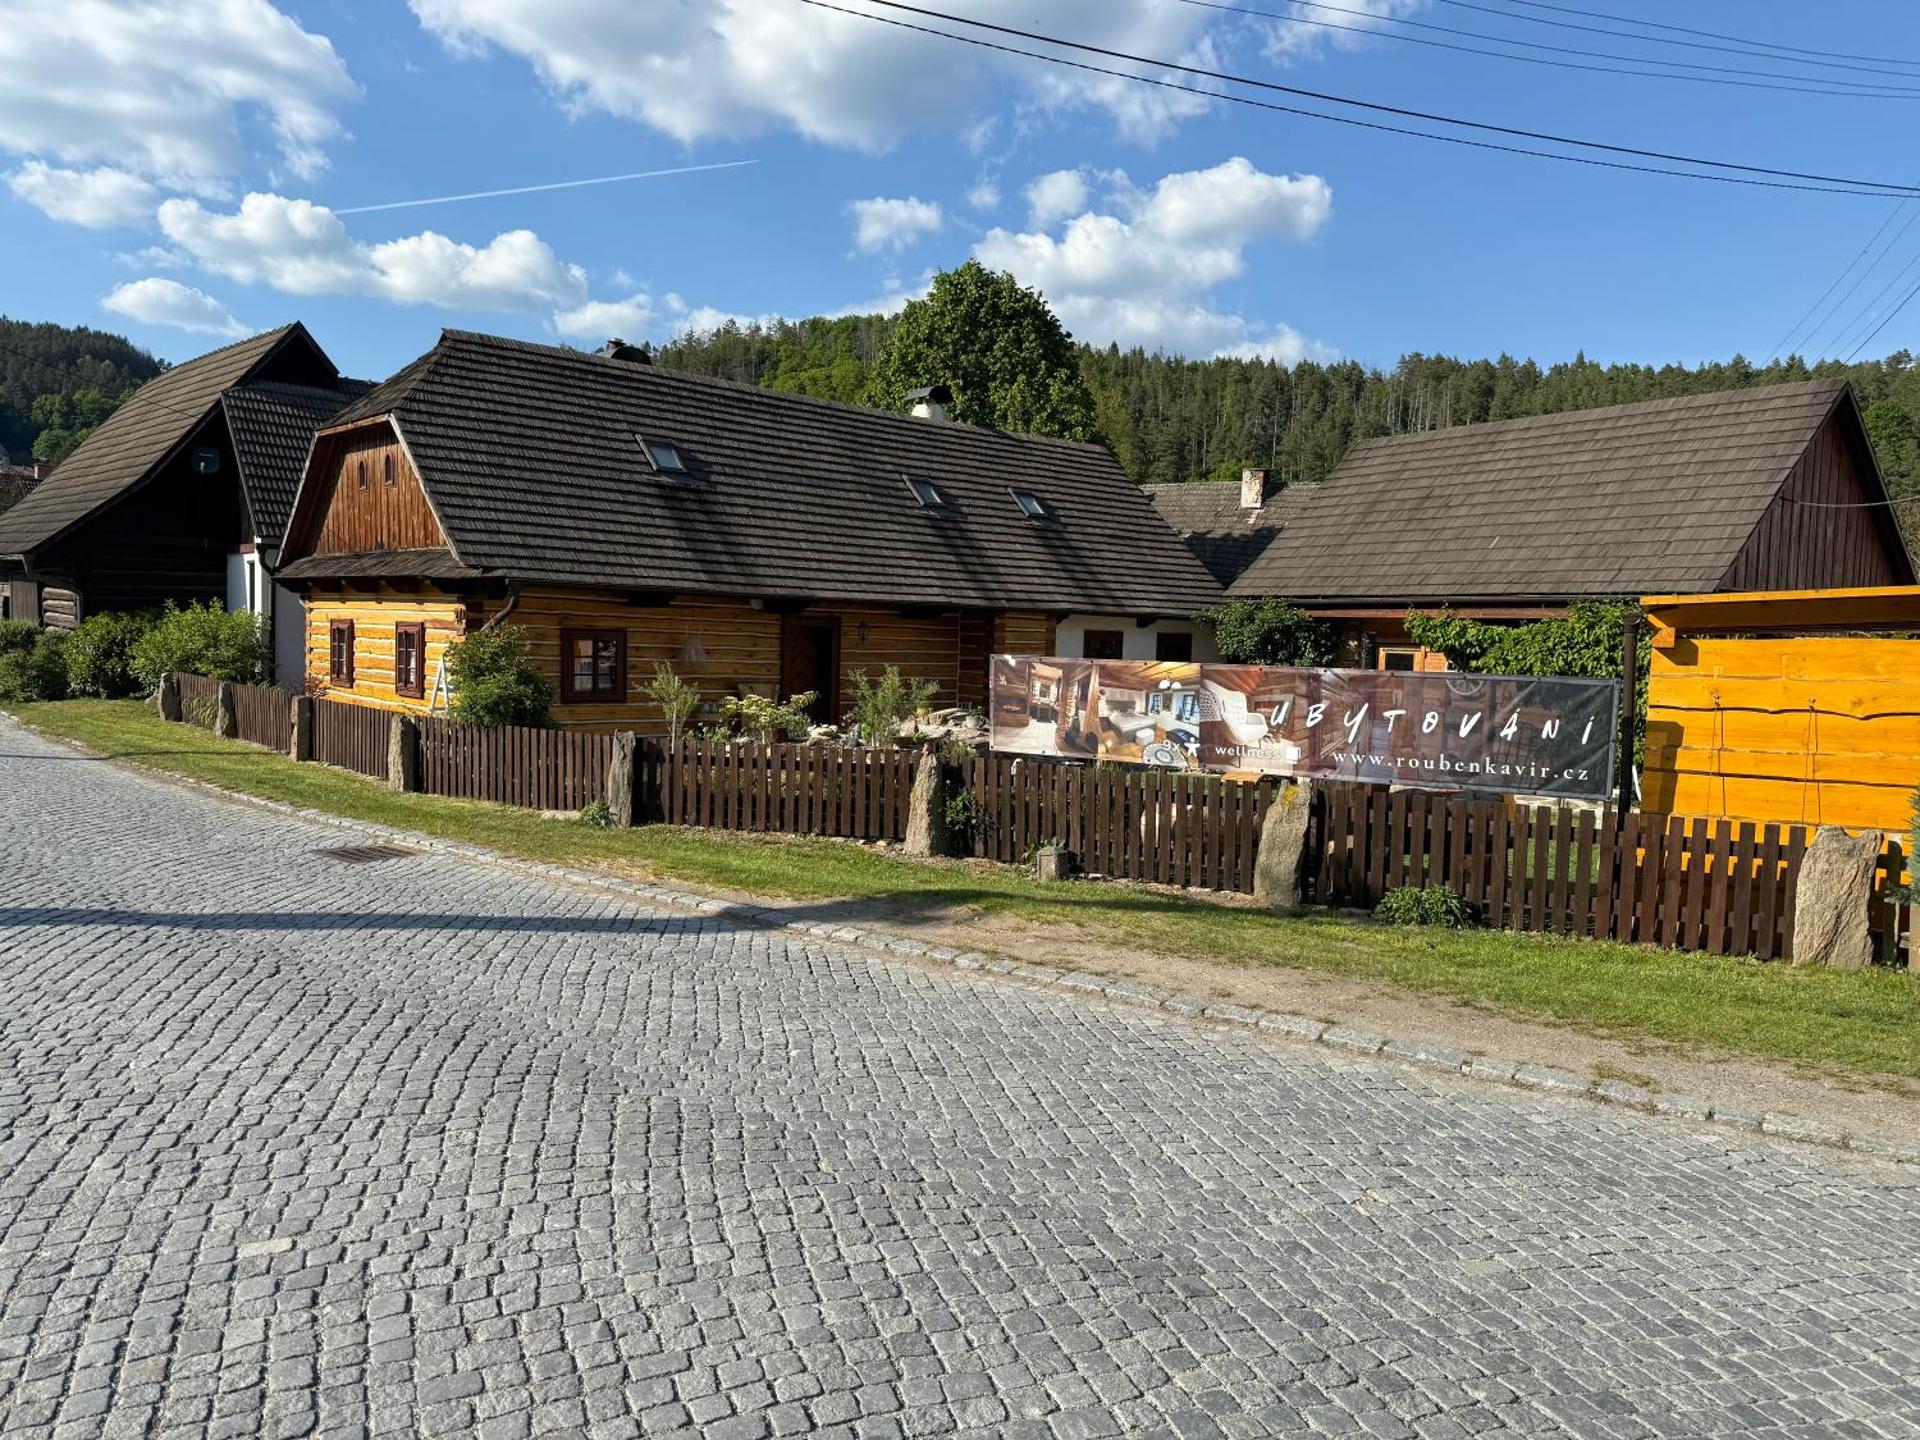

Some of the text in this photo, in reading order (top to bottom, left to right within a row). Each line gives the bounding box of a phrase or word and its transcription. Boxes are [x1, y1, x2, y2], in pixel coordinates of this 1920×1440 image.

[1270, 700, 1595, 745] UBYTOVÁNÍ
[1214, 744, 1281, 760] wellness
[1331, 751, 1589, 782] www.roubenkavir.cz
